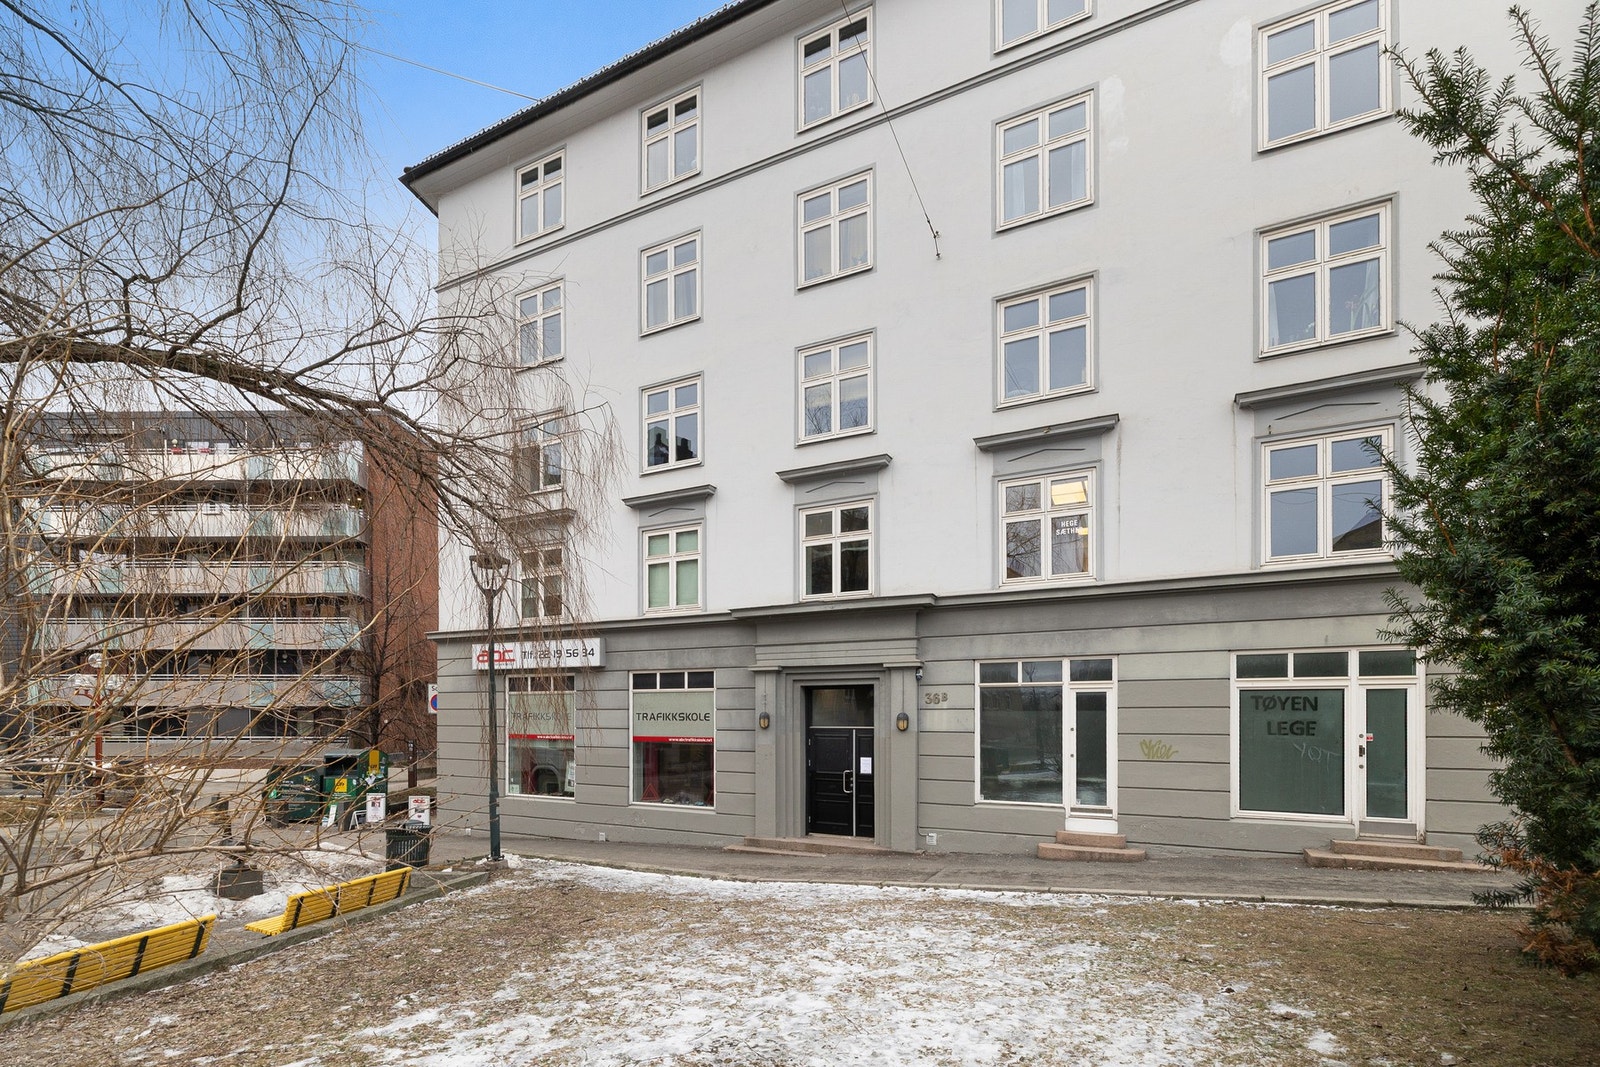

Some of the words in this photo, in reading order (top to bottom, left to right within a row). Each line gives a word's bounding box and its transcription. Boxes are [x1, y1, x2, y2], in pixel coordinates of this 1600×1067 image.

[553, 649, 563, 659] 19
[566, 648, 579, 658] 56
[1250, 695, 1318, 711] TØYEN
[636, 712, 711, 721] TRAFIKKSKOLE
[1266, 720, 1317, 736] LEGE
